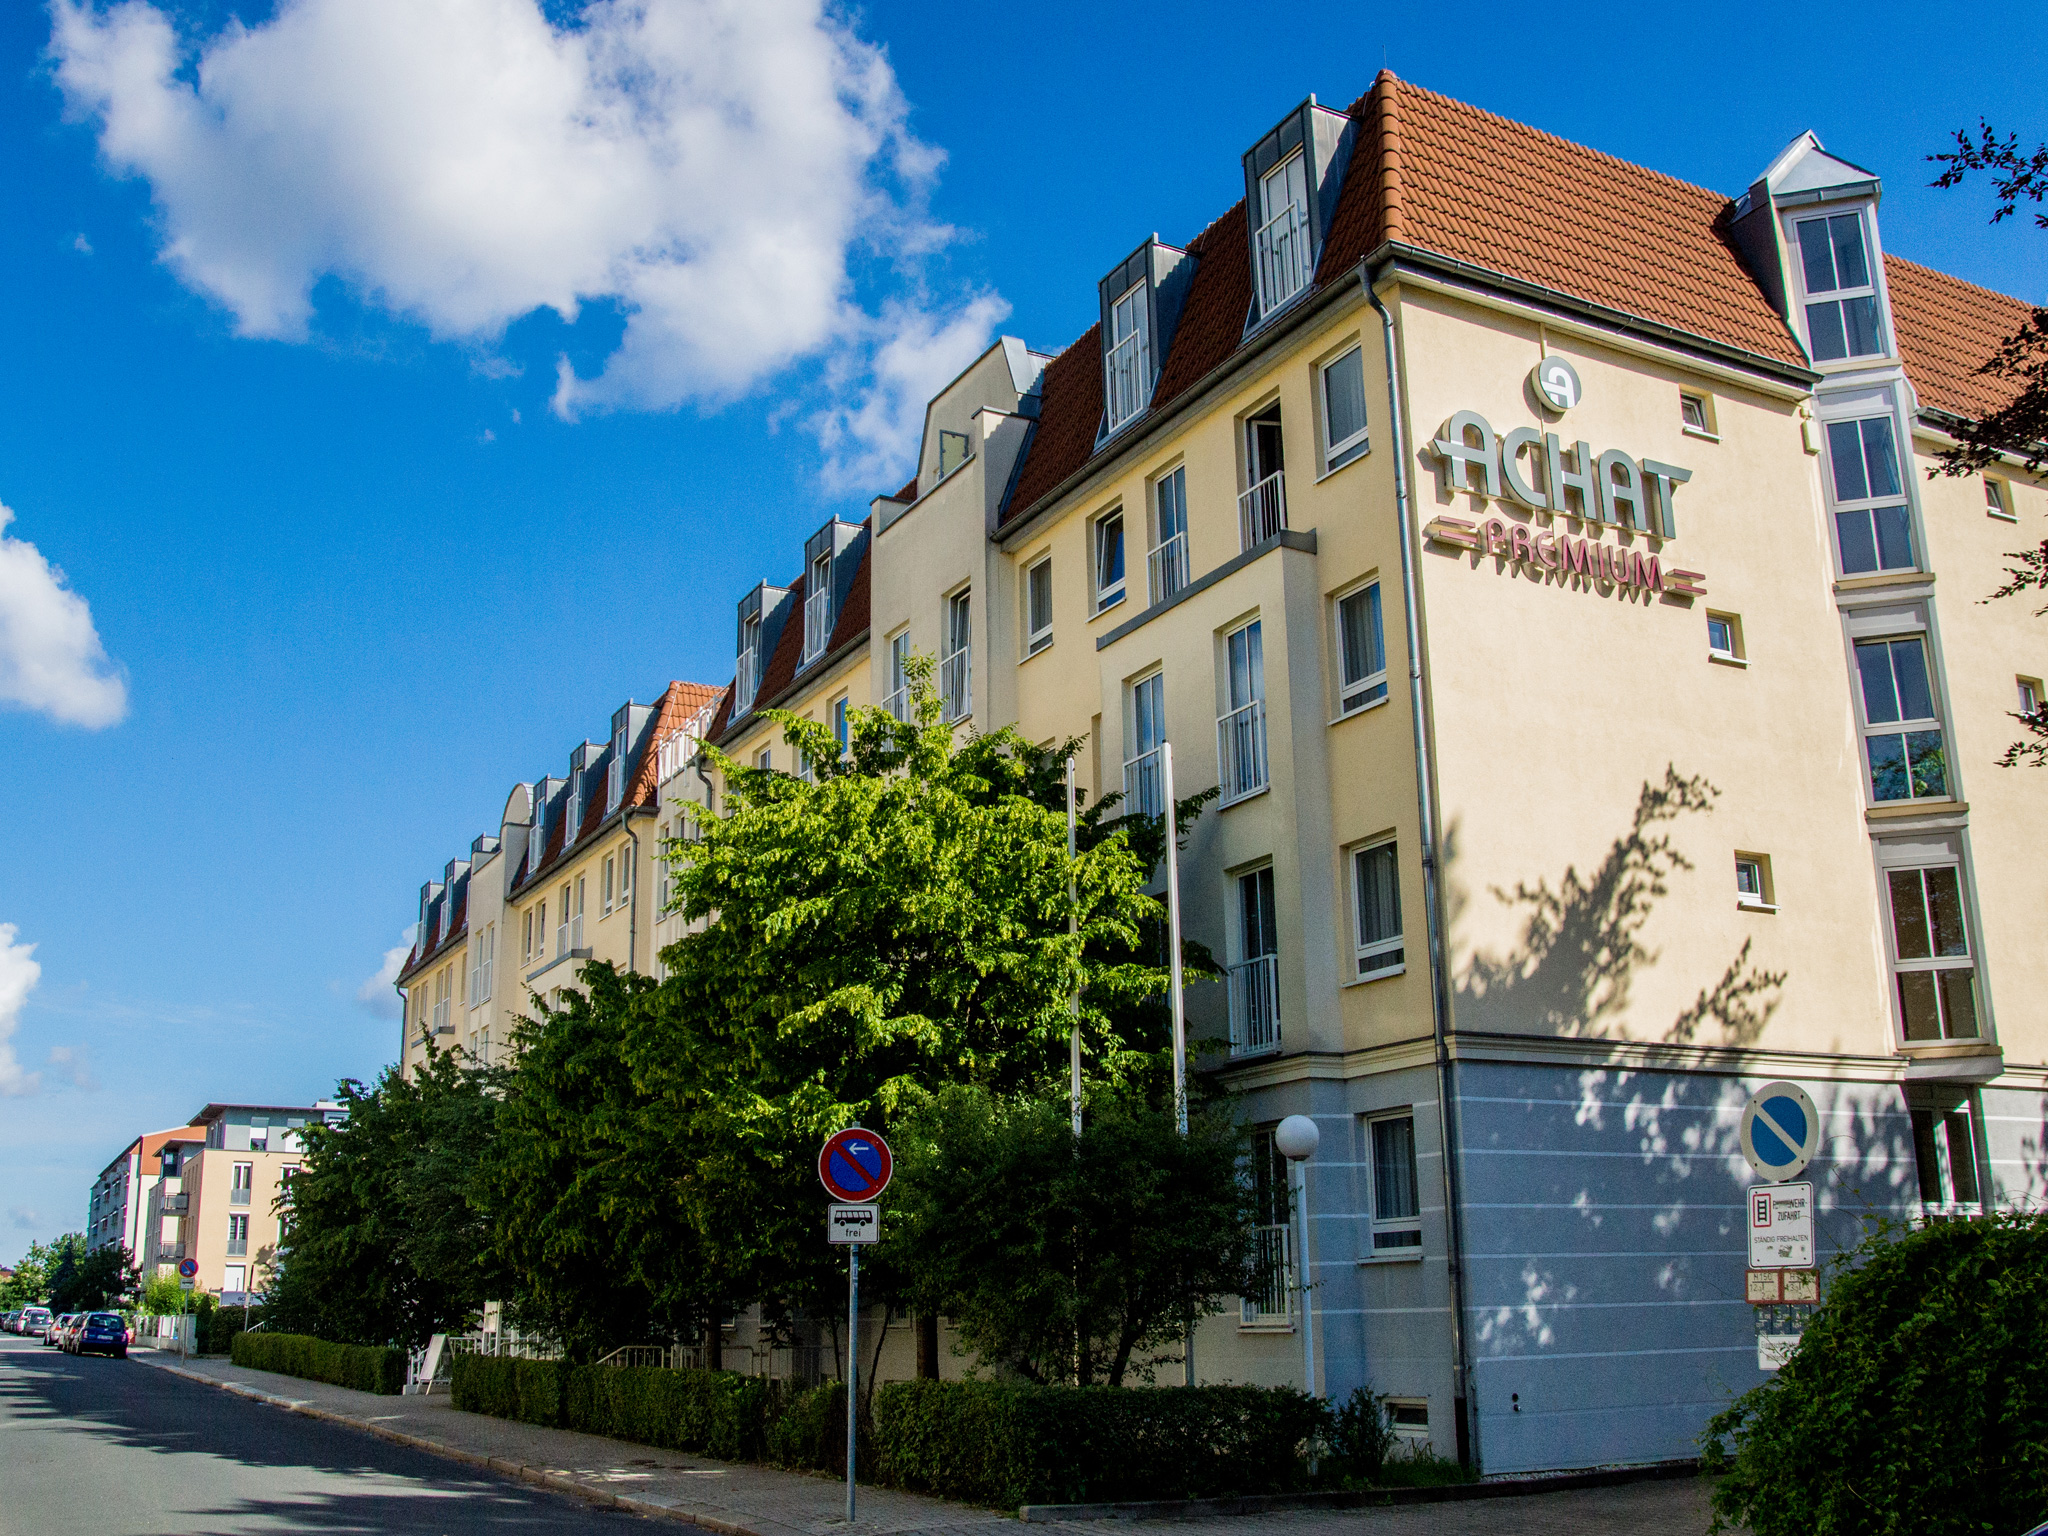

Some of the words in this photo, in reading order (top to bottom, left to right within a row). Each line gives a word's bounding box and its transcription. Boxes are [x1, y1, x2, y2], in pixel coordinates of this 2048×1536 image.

[1433, 410, 1693, 540] ACHAT
[1486, 518, 1665, 592] PREMIUM
[845, 1228, 862, 1237] frei
[1777, 1211, 1801, 1221] ZUFAHRT
